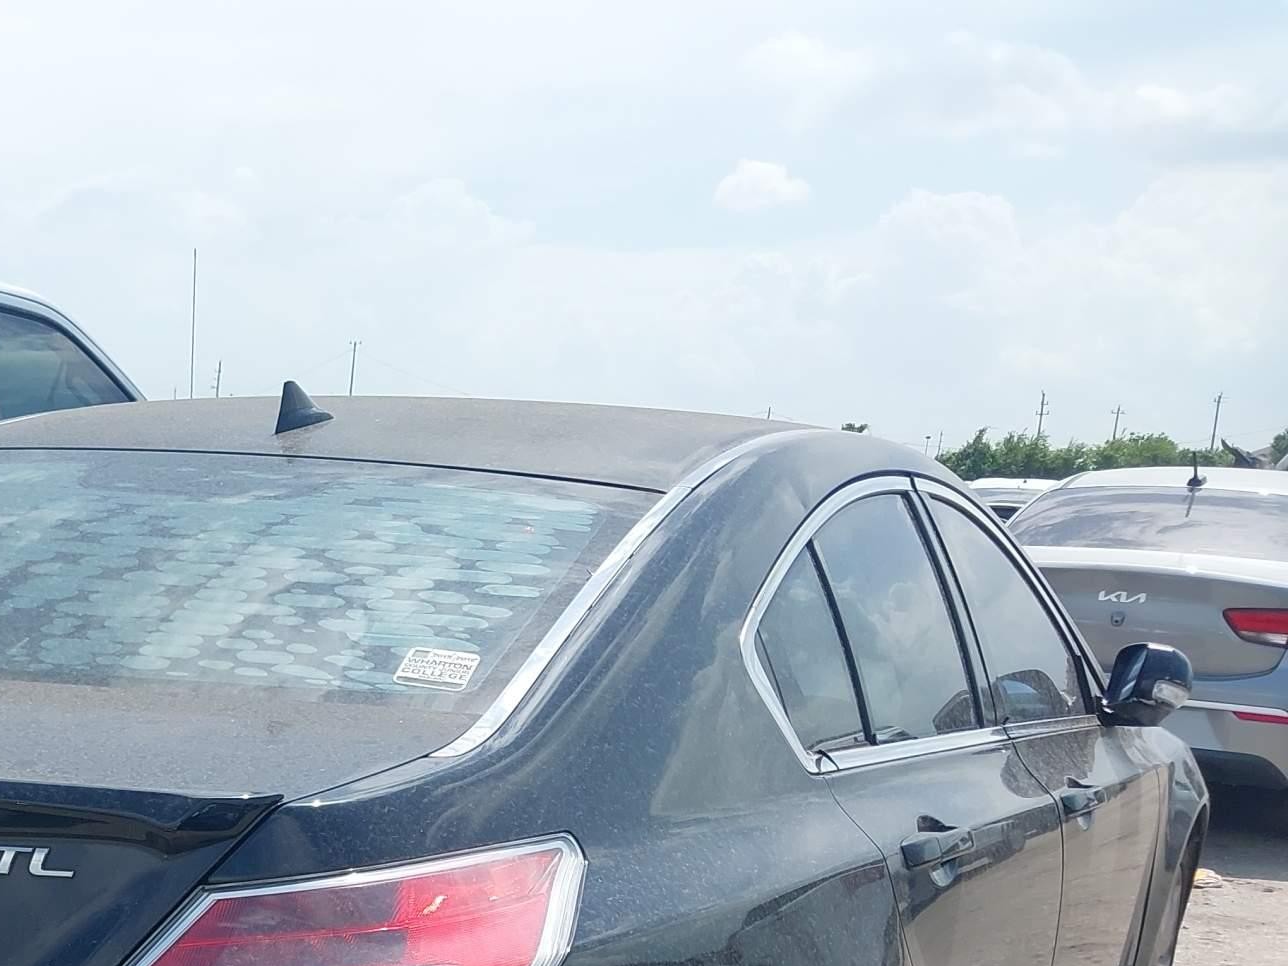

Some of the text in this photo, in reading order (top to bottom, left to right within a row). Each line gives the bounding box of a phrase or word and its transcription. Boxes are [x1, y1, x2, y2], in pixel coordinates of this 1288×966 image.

[1098, 590, 1146, 604] KIA
[408, 657, 473, 671] WHARTON
[401, 667, 468, 681] COLLEGE
